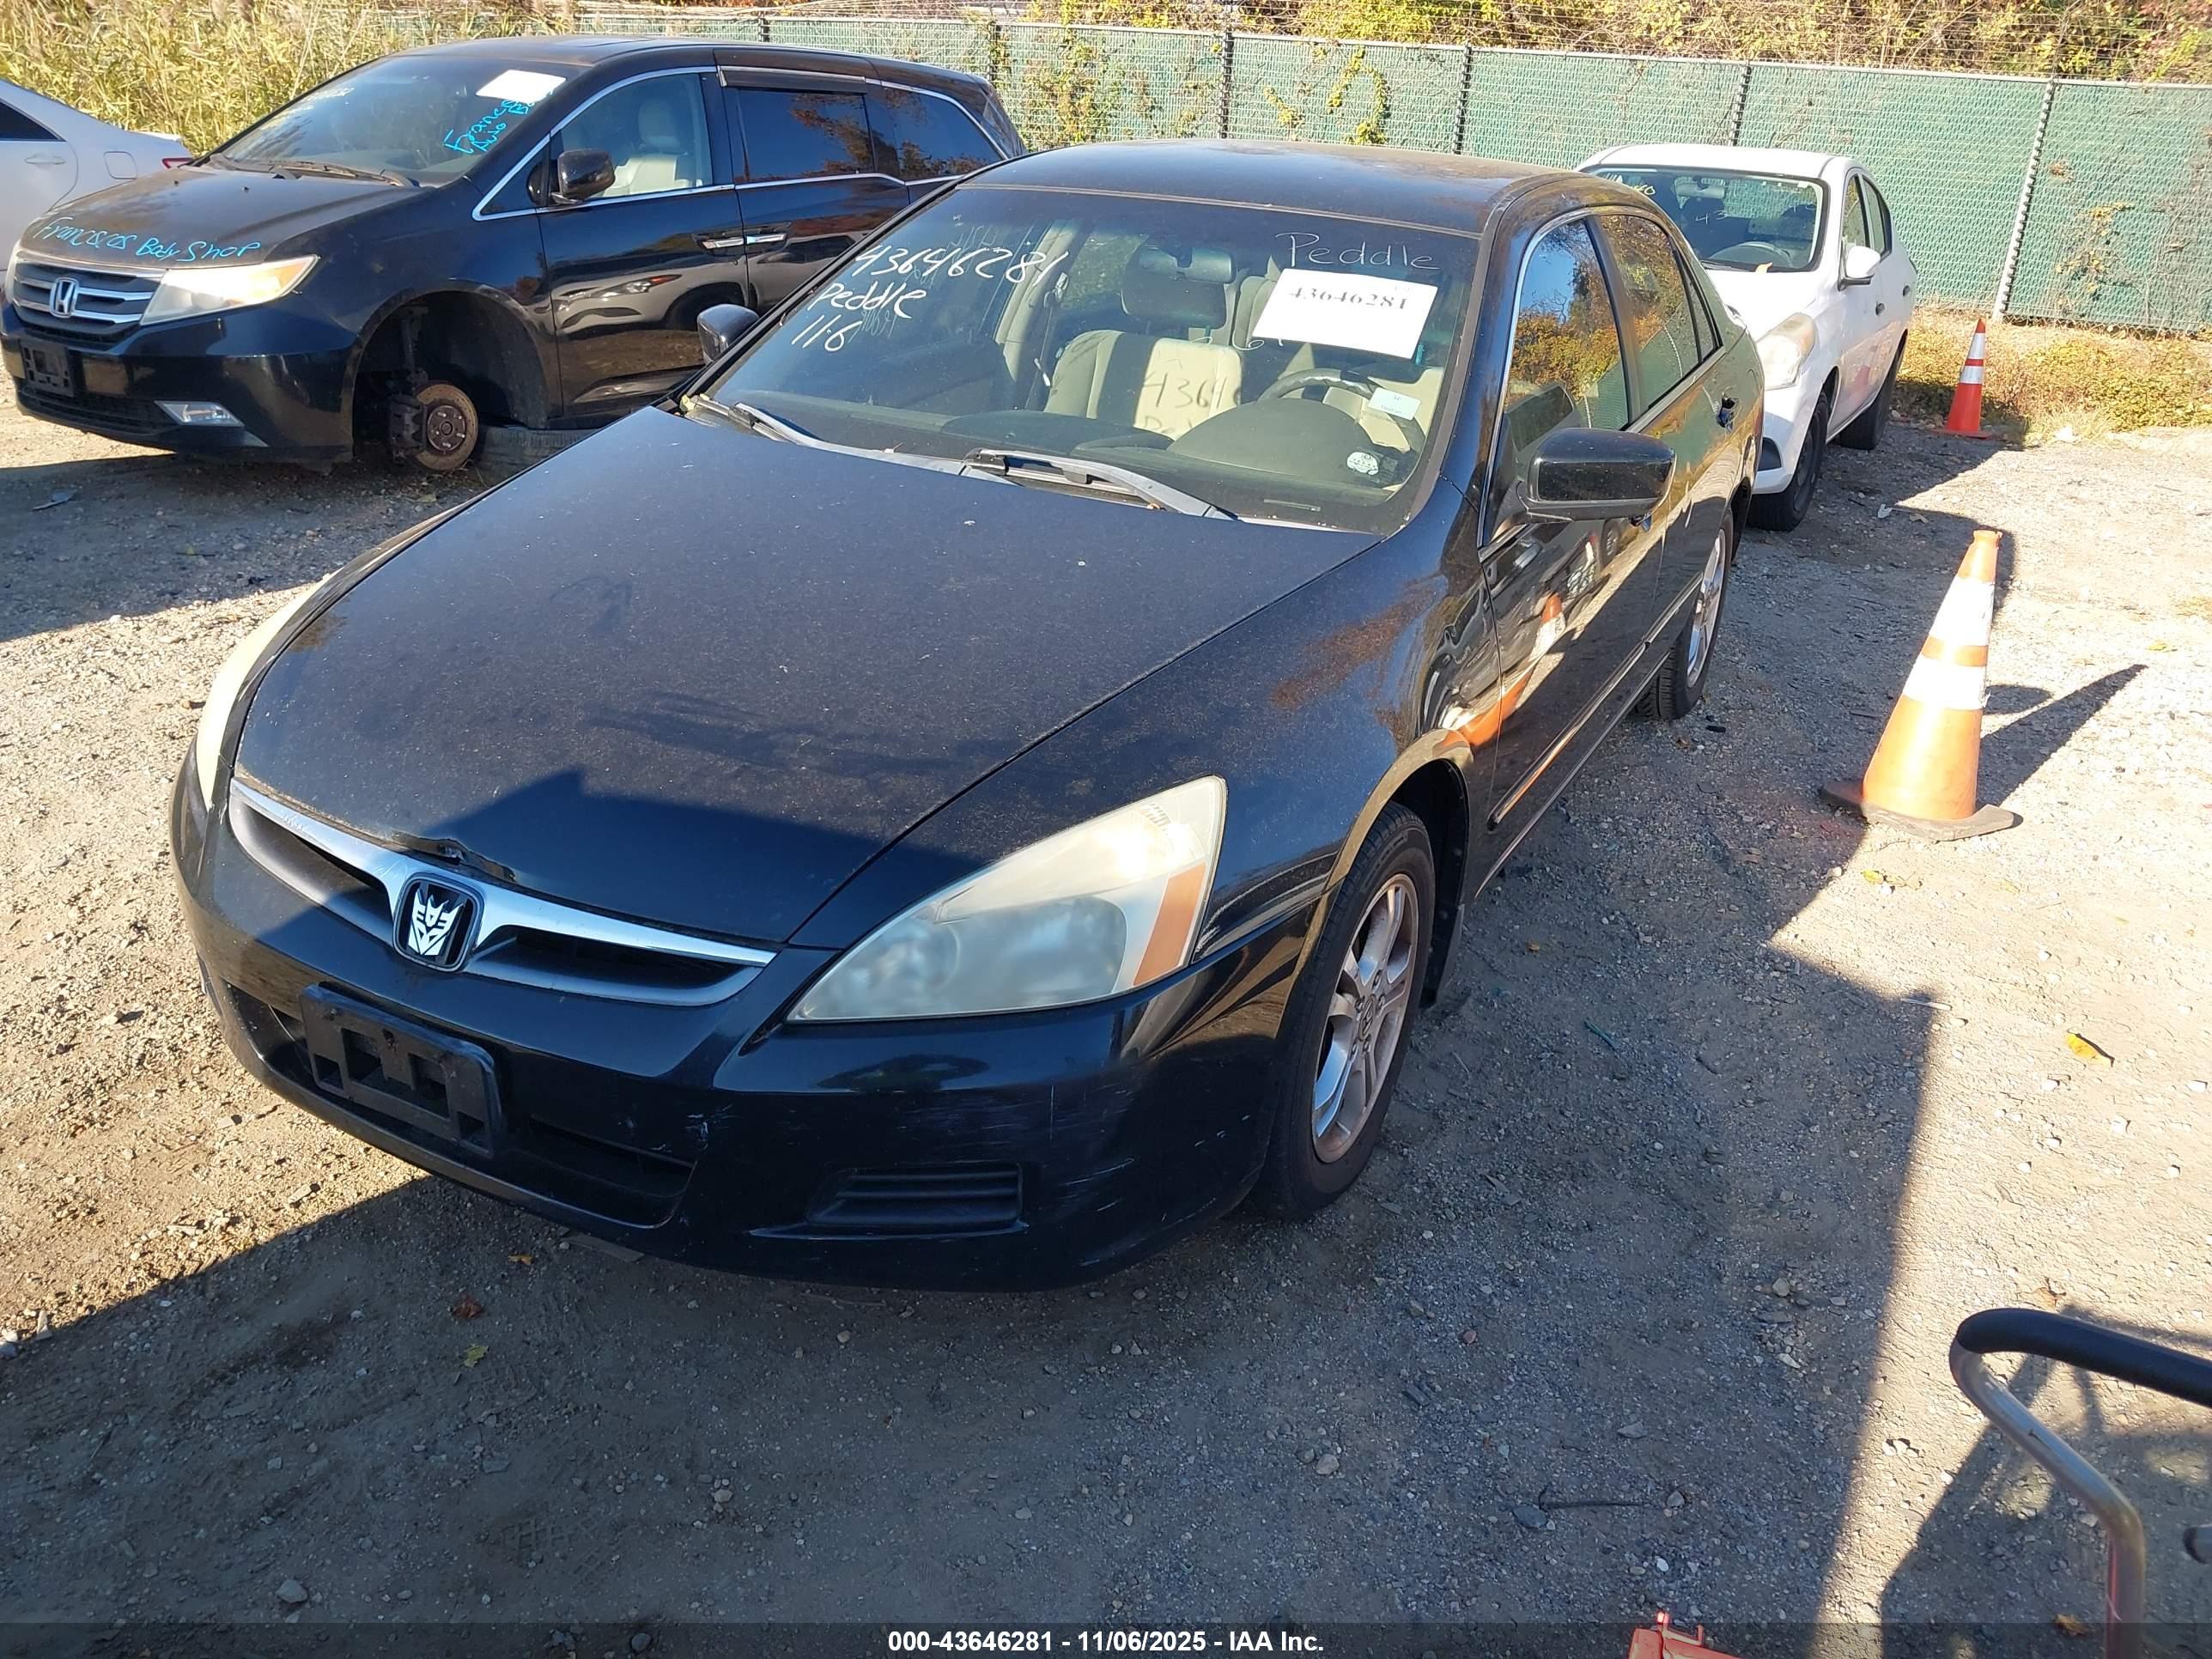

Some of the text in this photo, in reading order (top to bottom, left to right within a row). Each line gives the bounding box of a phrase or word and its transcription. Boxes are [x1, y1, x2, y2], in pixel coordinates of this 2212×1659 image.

[136, 237, 181, 261] Body
[176, 240, 262, 263] Shop
[851, 244, 1069, 287] 43646281
[1274, 231, 1440, 270] Peddle
[806, 280, 927, 319] Peddle
[1288, 287, 1411, 310] 43646281
